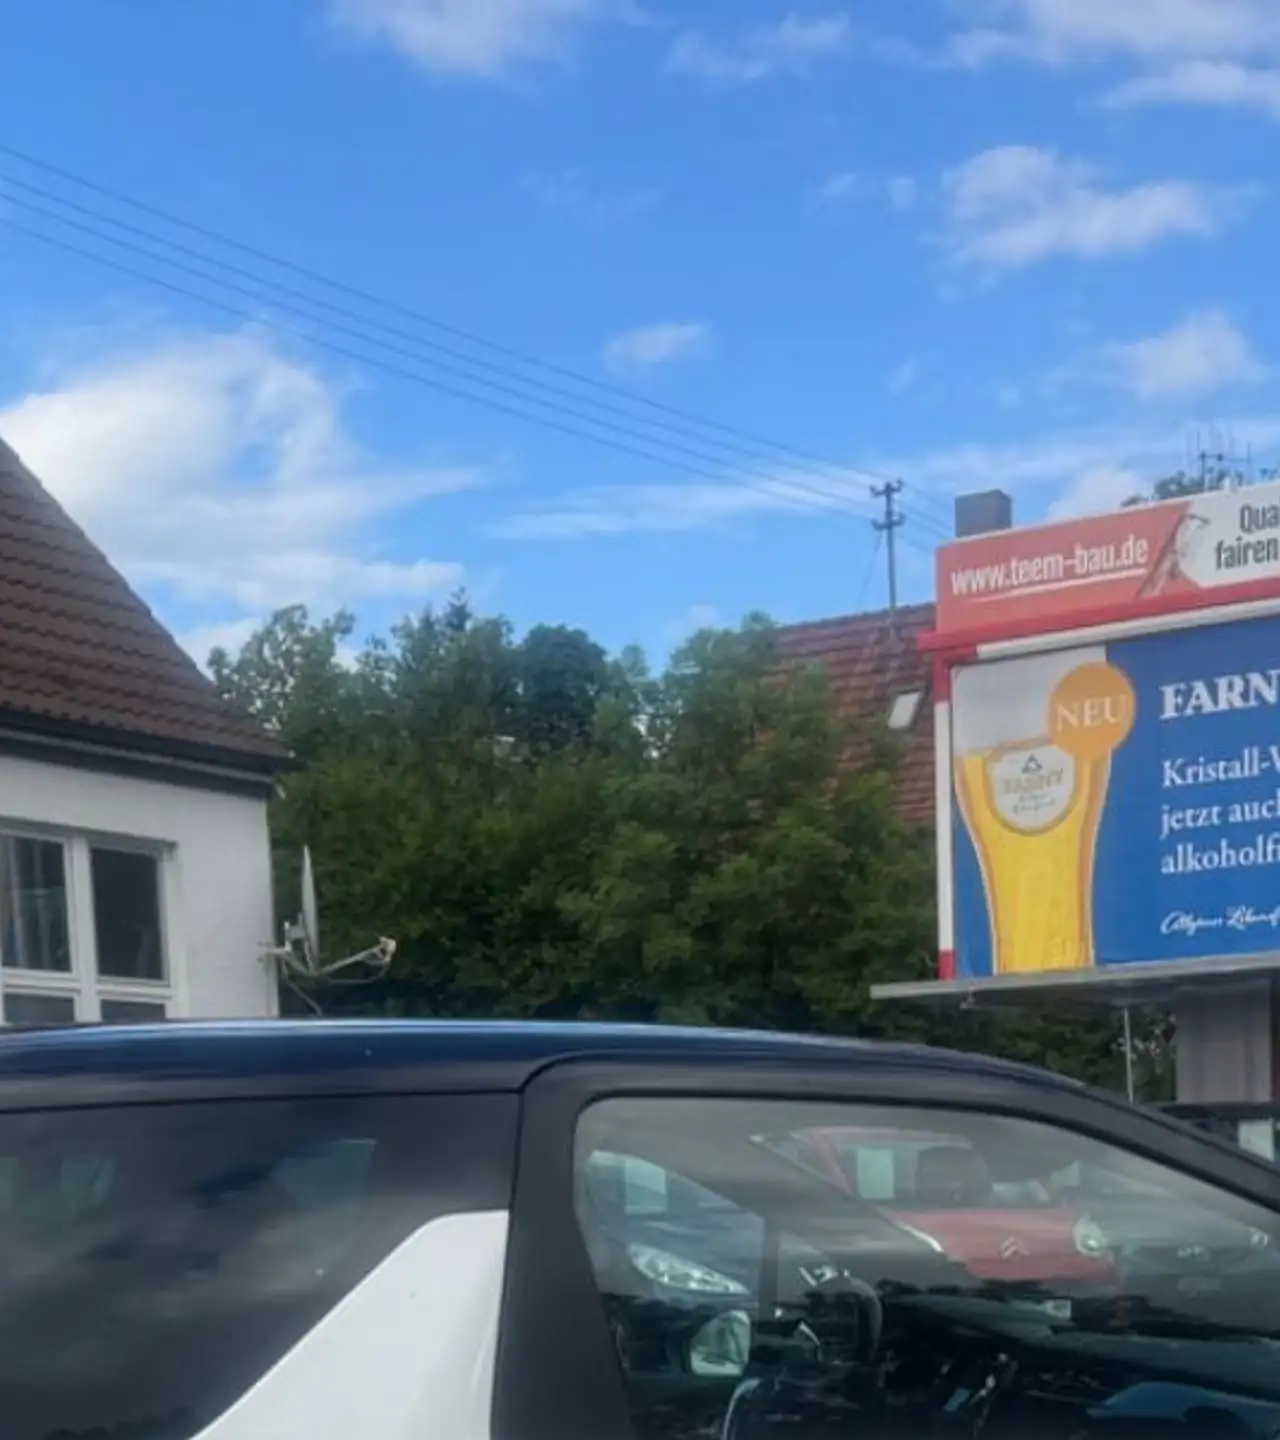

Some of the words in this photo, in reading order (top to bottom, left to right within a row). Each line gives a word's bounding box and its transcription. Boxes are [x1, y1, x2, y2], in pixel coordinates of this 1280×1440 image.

[1215, 535, 1280, 570] fairen
[1054, 693, 1128, 732] NEU
[1159, 804, 1224, 840] jetzt
